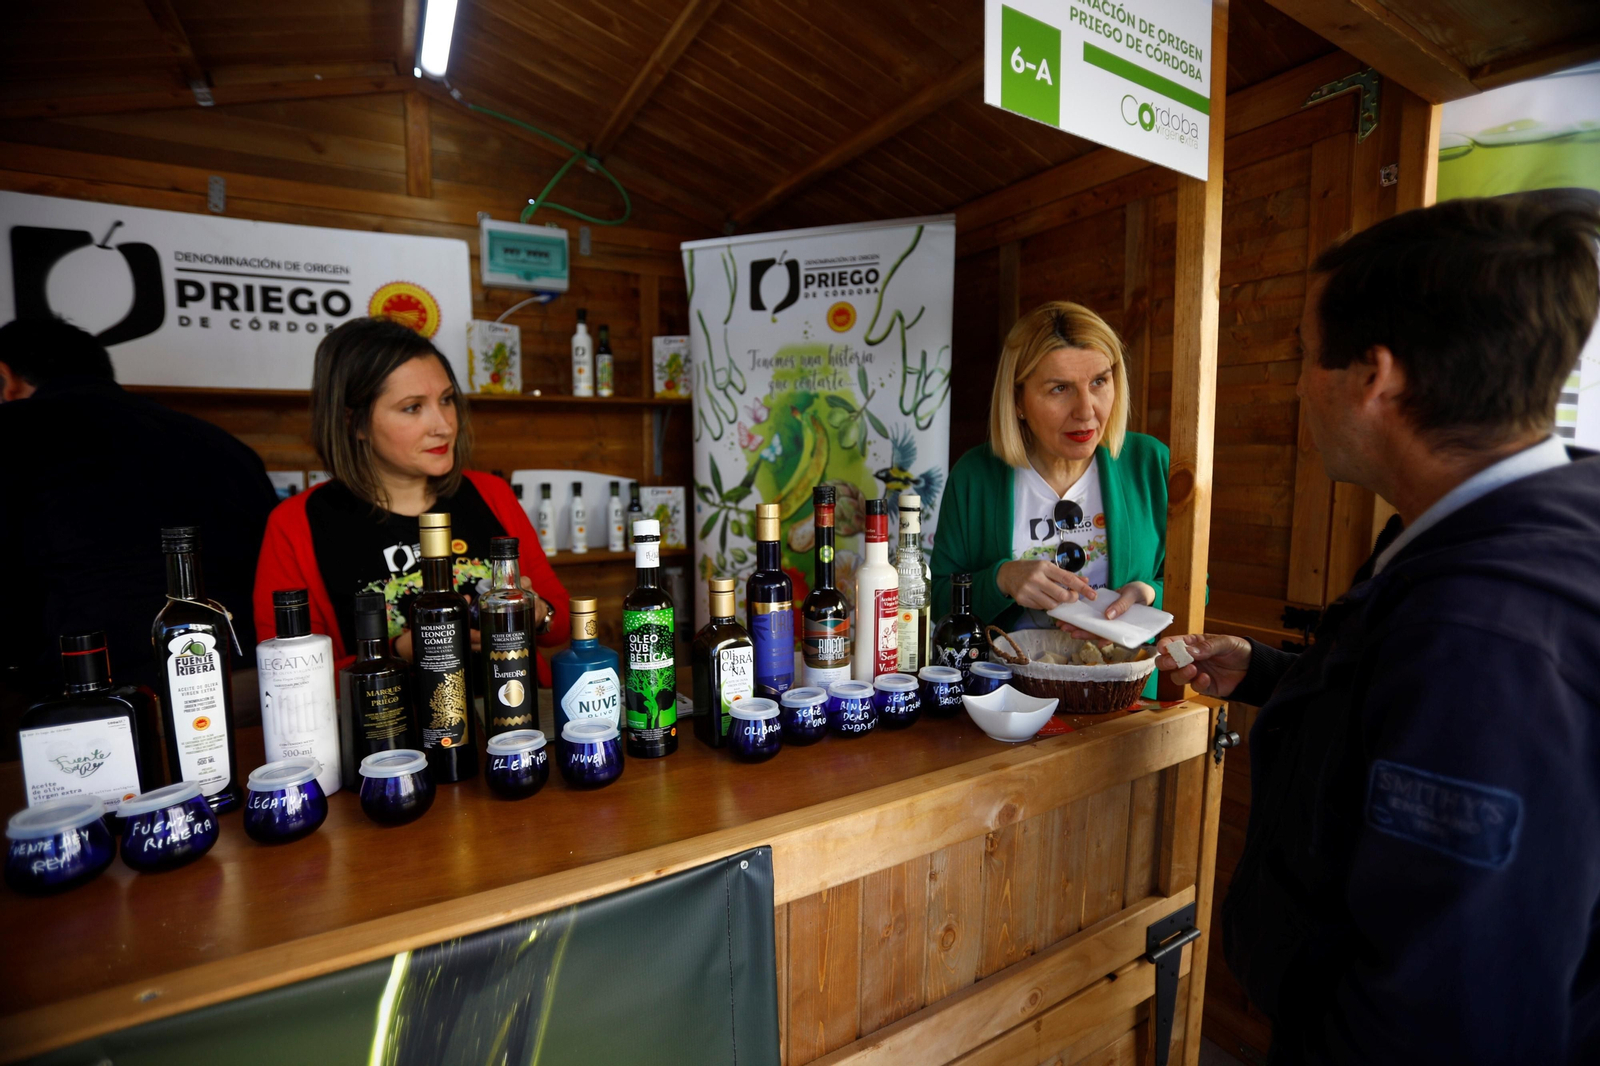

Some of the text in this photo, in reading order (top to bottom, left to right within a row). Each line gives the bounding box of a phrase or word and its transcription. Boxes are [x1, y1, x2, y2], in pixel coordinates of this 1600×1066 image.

[1070, 6, 1203, 82] PRIEGO DE CÓRDOBA
[1139, 18, 1155, 38] DE
[1158, 28, 1203, 62] ORIGEN
[1010, 46, 1053, 86] 6-A
[1120, 94, 1199, 140] Córdoba
[174, 250, 350, 275] DENOMINACIÓN DE ORIGEN
[804, 268, 880, 289] PRIEGO
[174, 279, 352, 317] PRIEGO
[824, 287, 880, 297] CÓRDOBA
[178, 315, 210, 328] DE
[747, 343, 874, 371] Tenemos una historia
[768, 378, 788, 400] que
[420, 624, 444, 632] MOLINO
[421, 630, 456, 638] LEONCIO
[424, 637, 452, 646] GÓMEZ
[629, 634, 658, 644] OLEO
[629, 644, 648, 653] SUB
[175, 654, 214, 668] FUENTE
[260, 652, 324, 671] LEGATVM
[176, 666, 216, 676] RIBERA
[494, 669, 526, 678] EMPIEDRO
[933, 685, 961, 694] VENTA
[578, 694, 617, 714] NUVE
[885, 706, 896, 714] DE
[587, 709, 613, 718] OLIVO
[844, 712, 855, 721] DE
[813, 718, 826, 728] ORO
[282, 748, 313, 758] 500 ml
[571, 753, 599, 764] NUVE
[49, 749, 112, 773] Fuente
[493, 758, 508, 770] EL
[31, 782, 57, 790] Aceite
[44, 786, 65, 794] oliva
[33, 788, 82, 801] virgen extra
[132, 811, 195, 836] FUENTE
[144, 819, 212, 852] RIBERA
[32, 858, 66, 875] REY
